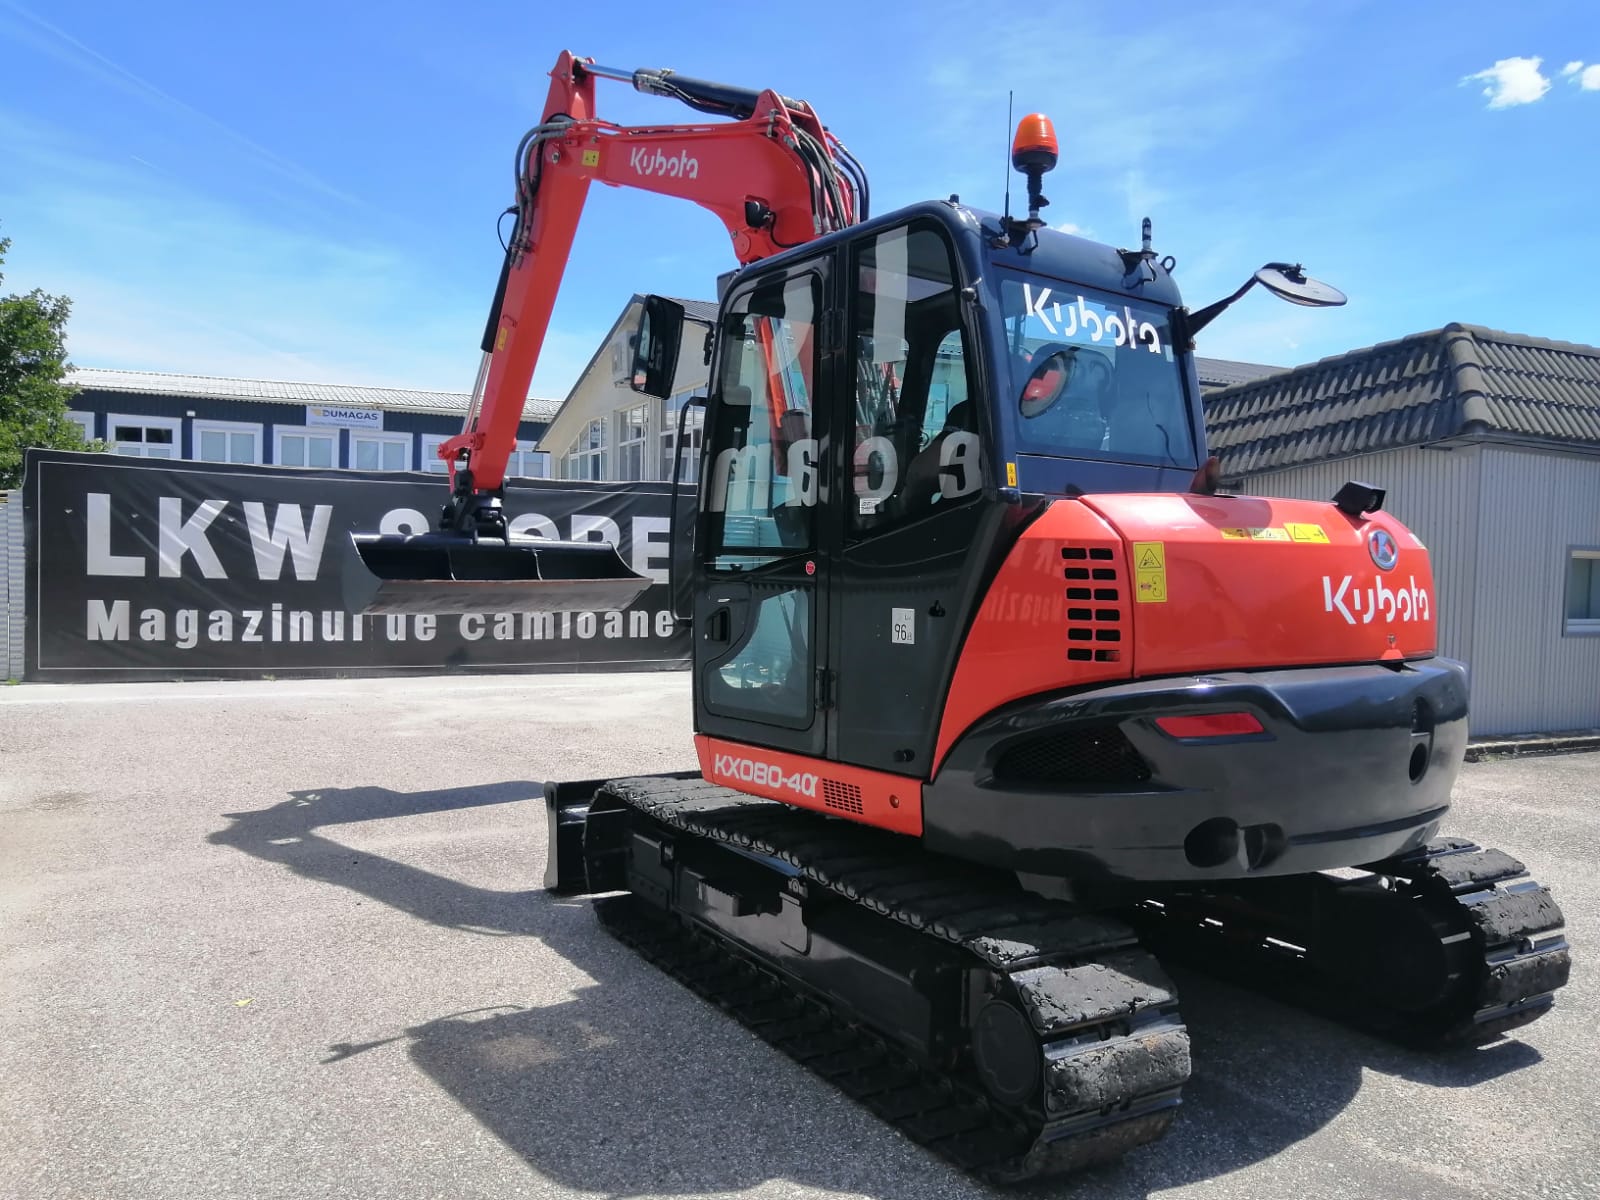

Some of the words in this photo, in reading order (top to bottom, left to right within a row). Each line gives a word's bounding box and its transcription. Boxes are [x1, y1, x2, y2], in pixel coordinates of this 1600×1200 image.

[629, 147, 699, 179] Kubota
[1023, 283, 1162, 354] Kubota
[322, 409, 379, 421] DUMAGAS
[86, 492, 334, 581] LKW
[86, 599, 363, 649] Magazinul
[386, 613, 438, 642] de
[459, 608, 675, 641] camioane
[1322, 575, 1430, 625] Kubota
[894, 623, 907, 641] 96
